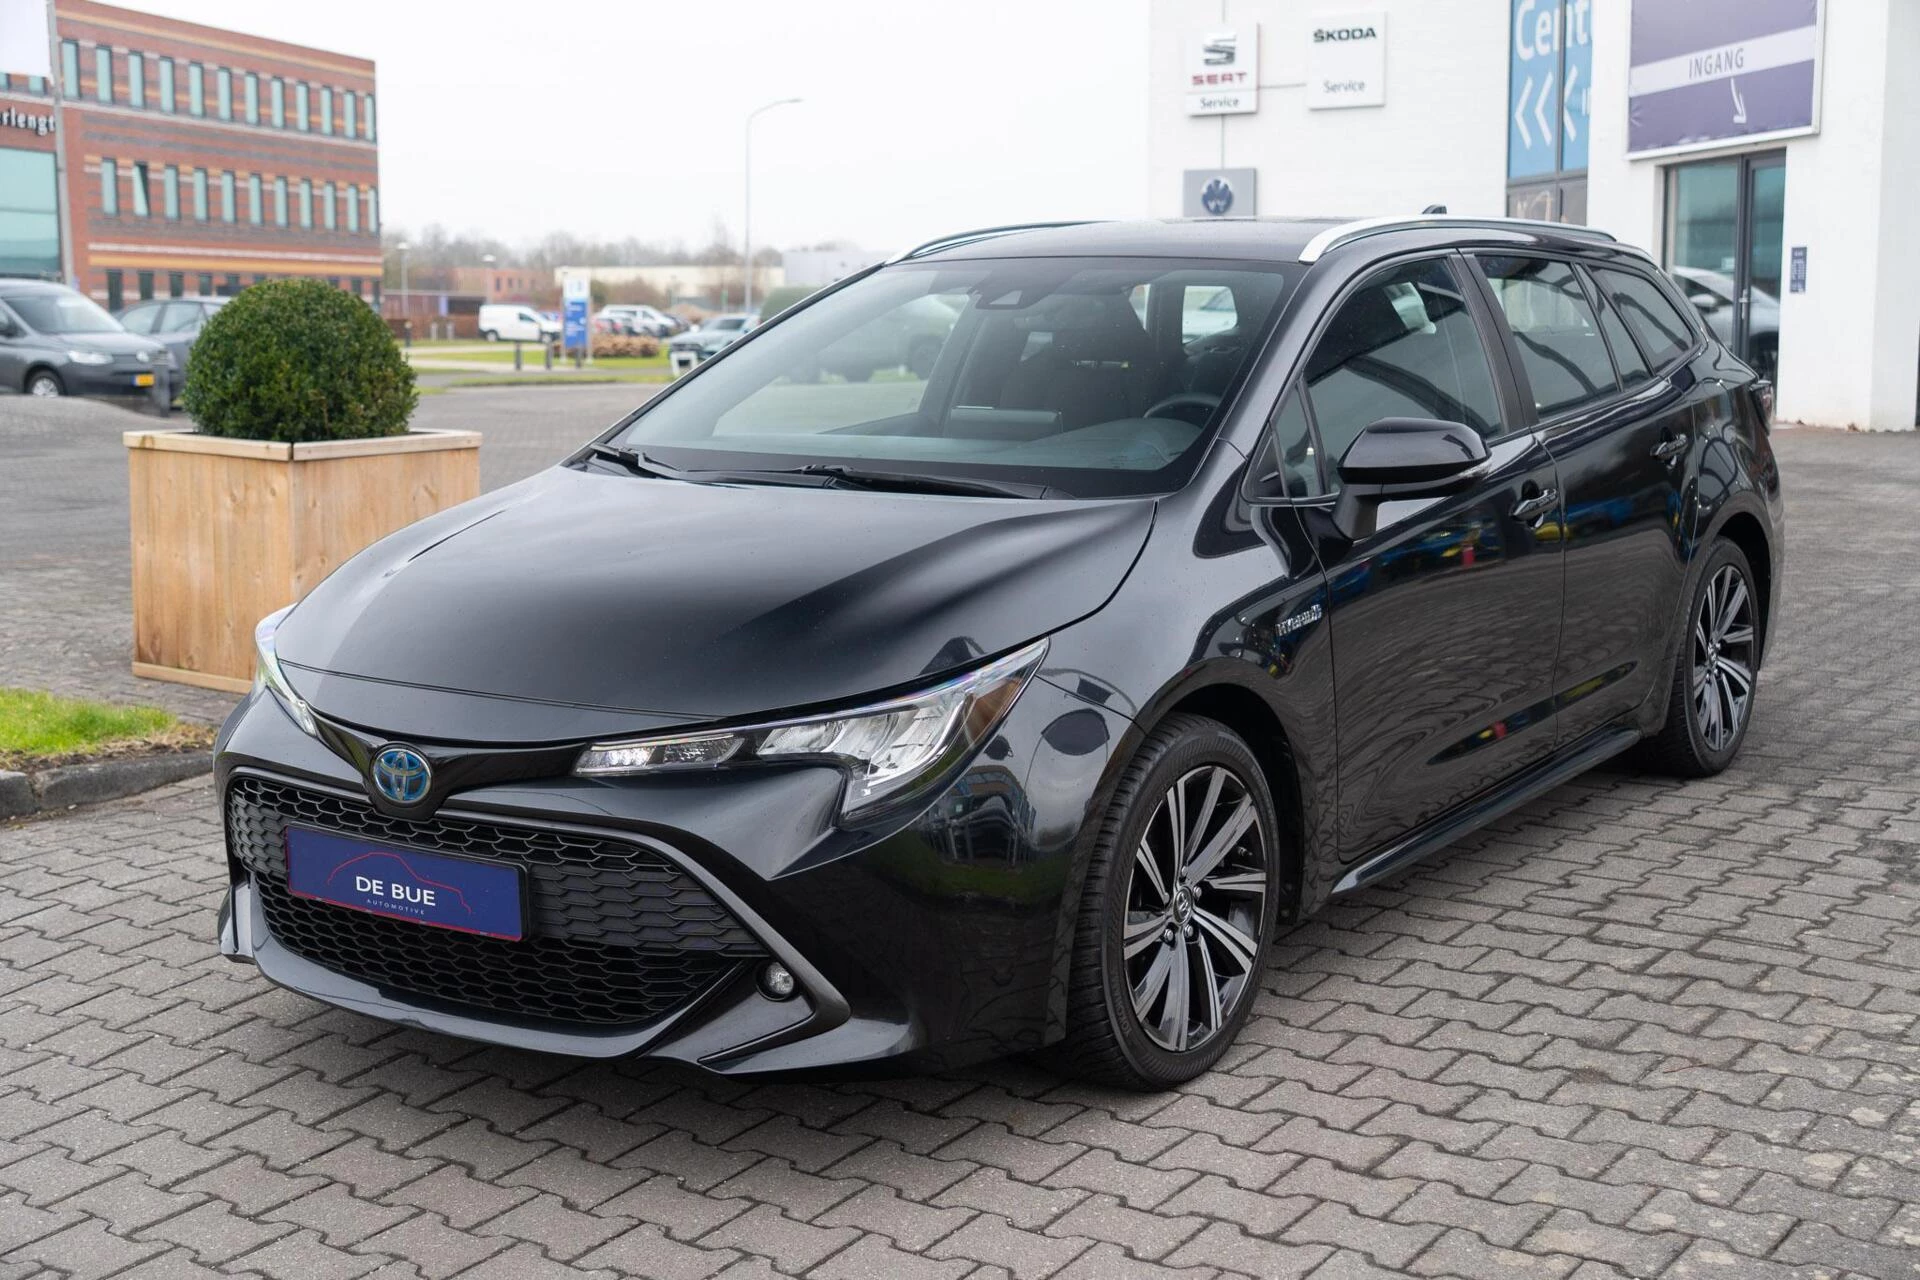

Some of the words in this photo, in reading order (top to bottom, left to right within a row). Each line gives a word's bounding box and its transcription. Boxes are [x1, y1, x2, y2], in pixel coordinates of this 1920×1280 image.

[1313, 27, 1376, 43] ŠKODA
[1516, 0, 1593, 60] Cent
[1688, 48, 1745, 79] INGANG
[1192, 72, 1247, 85] SEAT
[1323, 80, 1365, 93] Service
[1201, 97, 1239, 109] Service
[0, 106, 55, 136] rlengt
[356, 875, 384, 896] DE
[391, 883, 436, 907] BUE
[367, 899, 425, 915] AUTOMOTIVE
